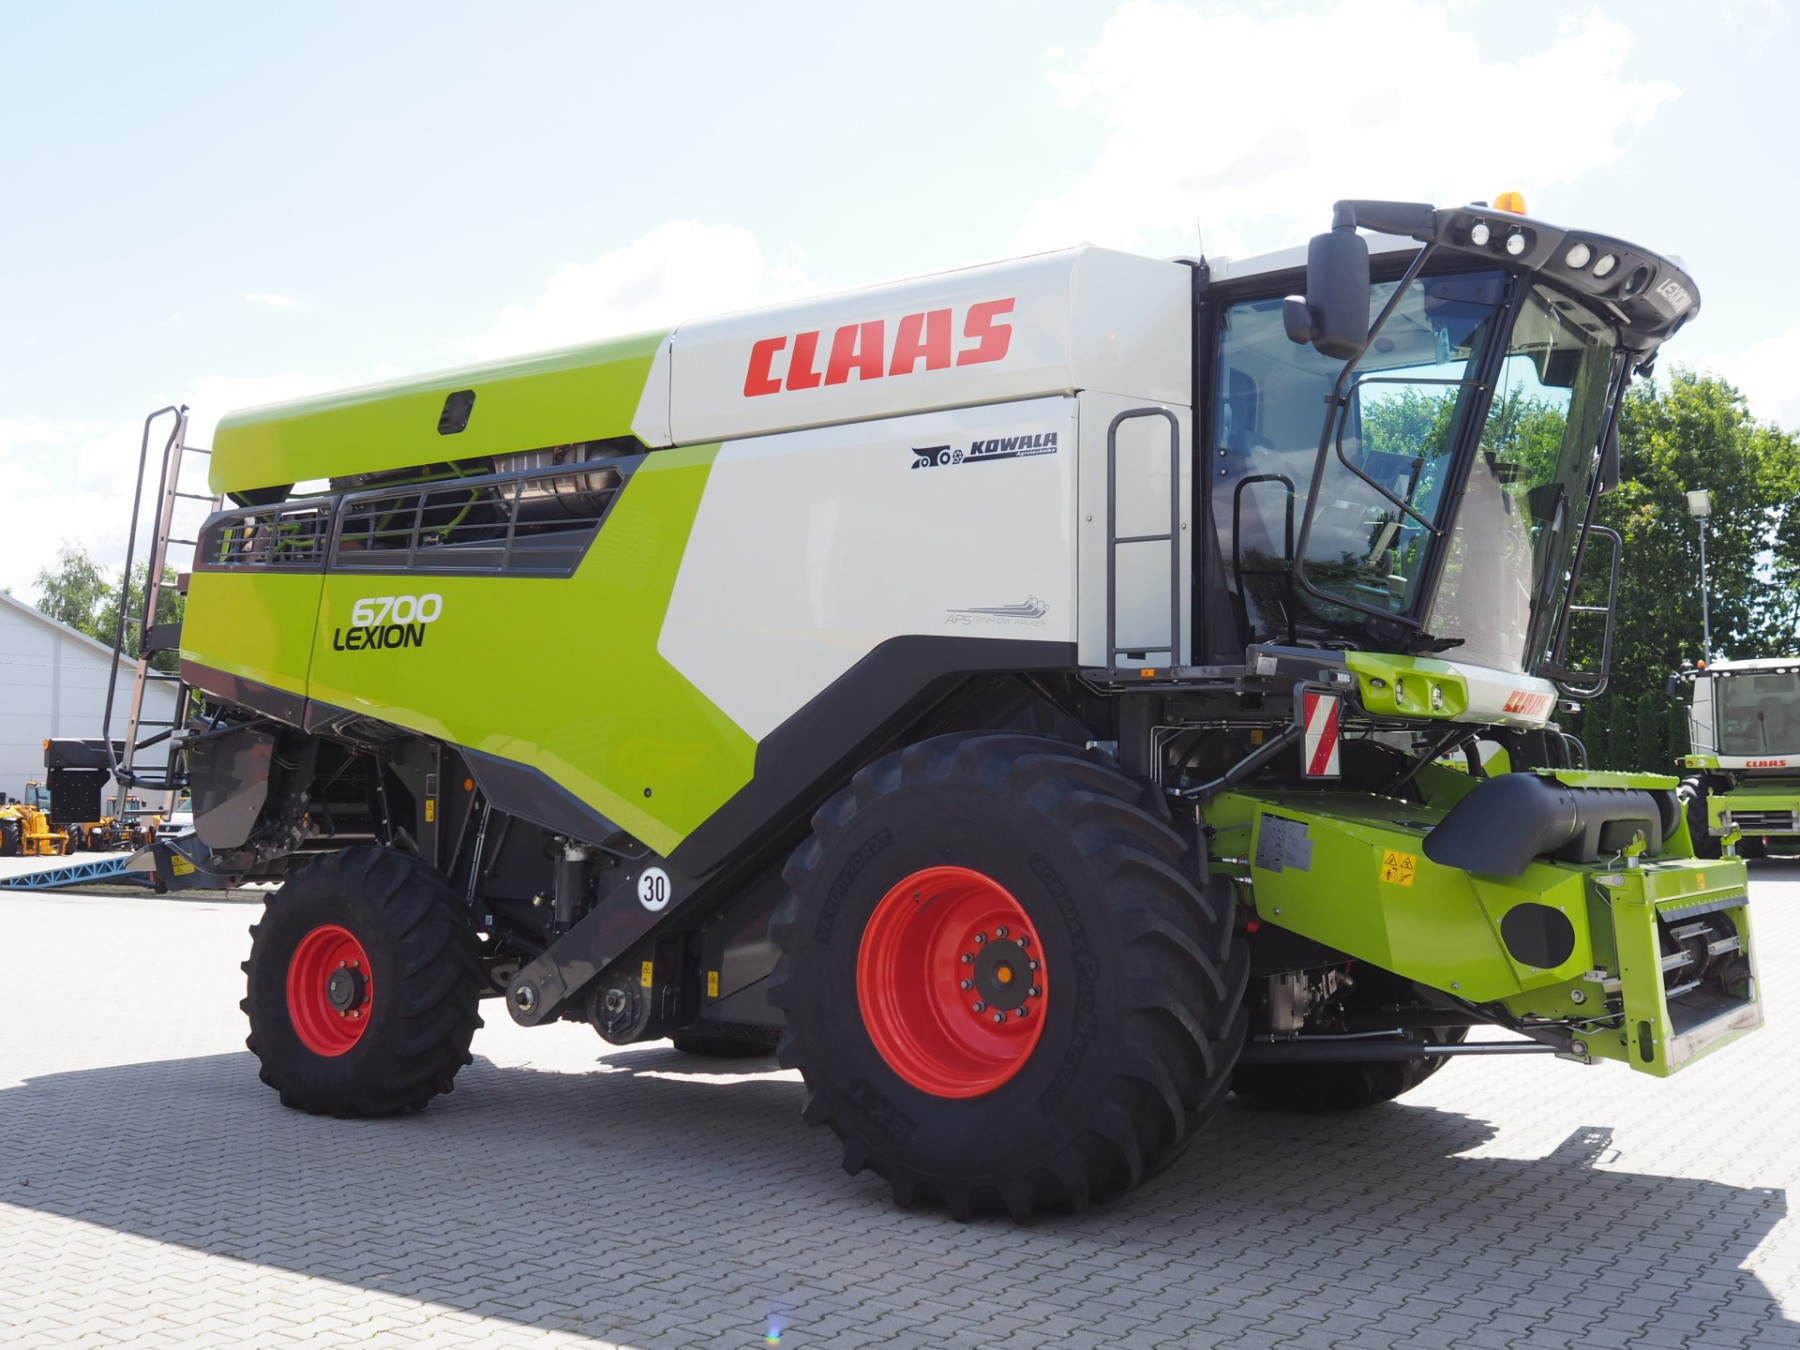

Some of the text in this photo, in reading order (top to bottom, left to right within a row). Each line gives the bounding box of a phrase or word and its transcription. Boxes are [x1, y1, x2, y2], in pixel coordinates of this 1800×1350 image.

[743, 297, 1016, 398] CLAAS
[970, 432, 1058, 455] KOWALA
[1016, 448, 1056, 457] Agrotechnika
[352, 593, 443, 628] 6700
[945, 614, 973, 625] APS
[333, 623, 426, 651] LEXION
[1502, 690, 1551, 715] CLAAS
[1745, 759, 1787, 768] CLAAS
[643, 875, 665, 903] 30
